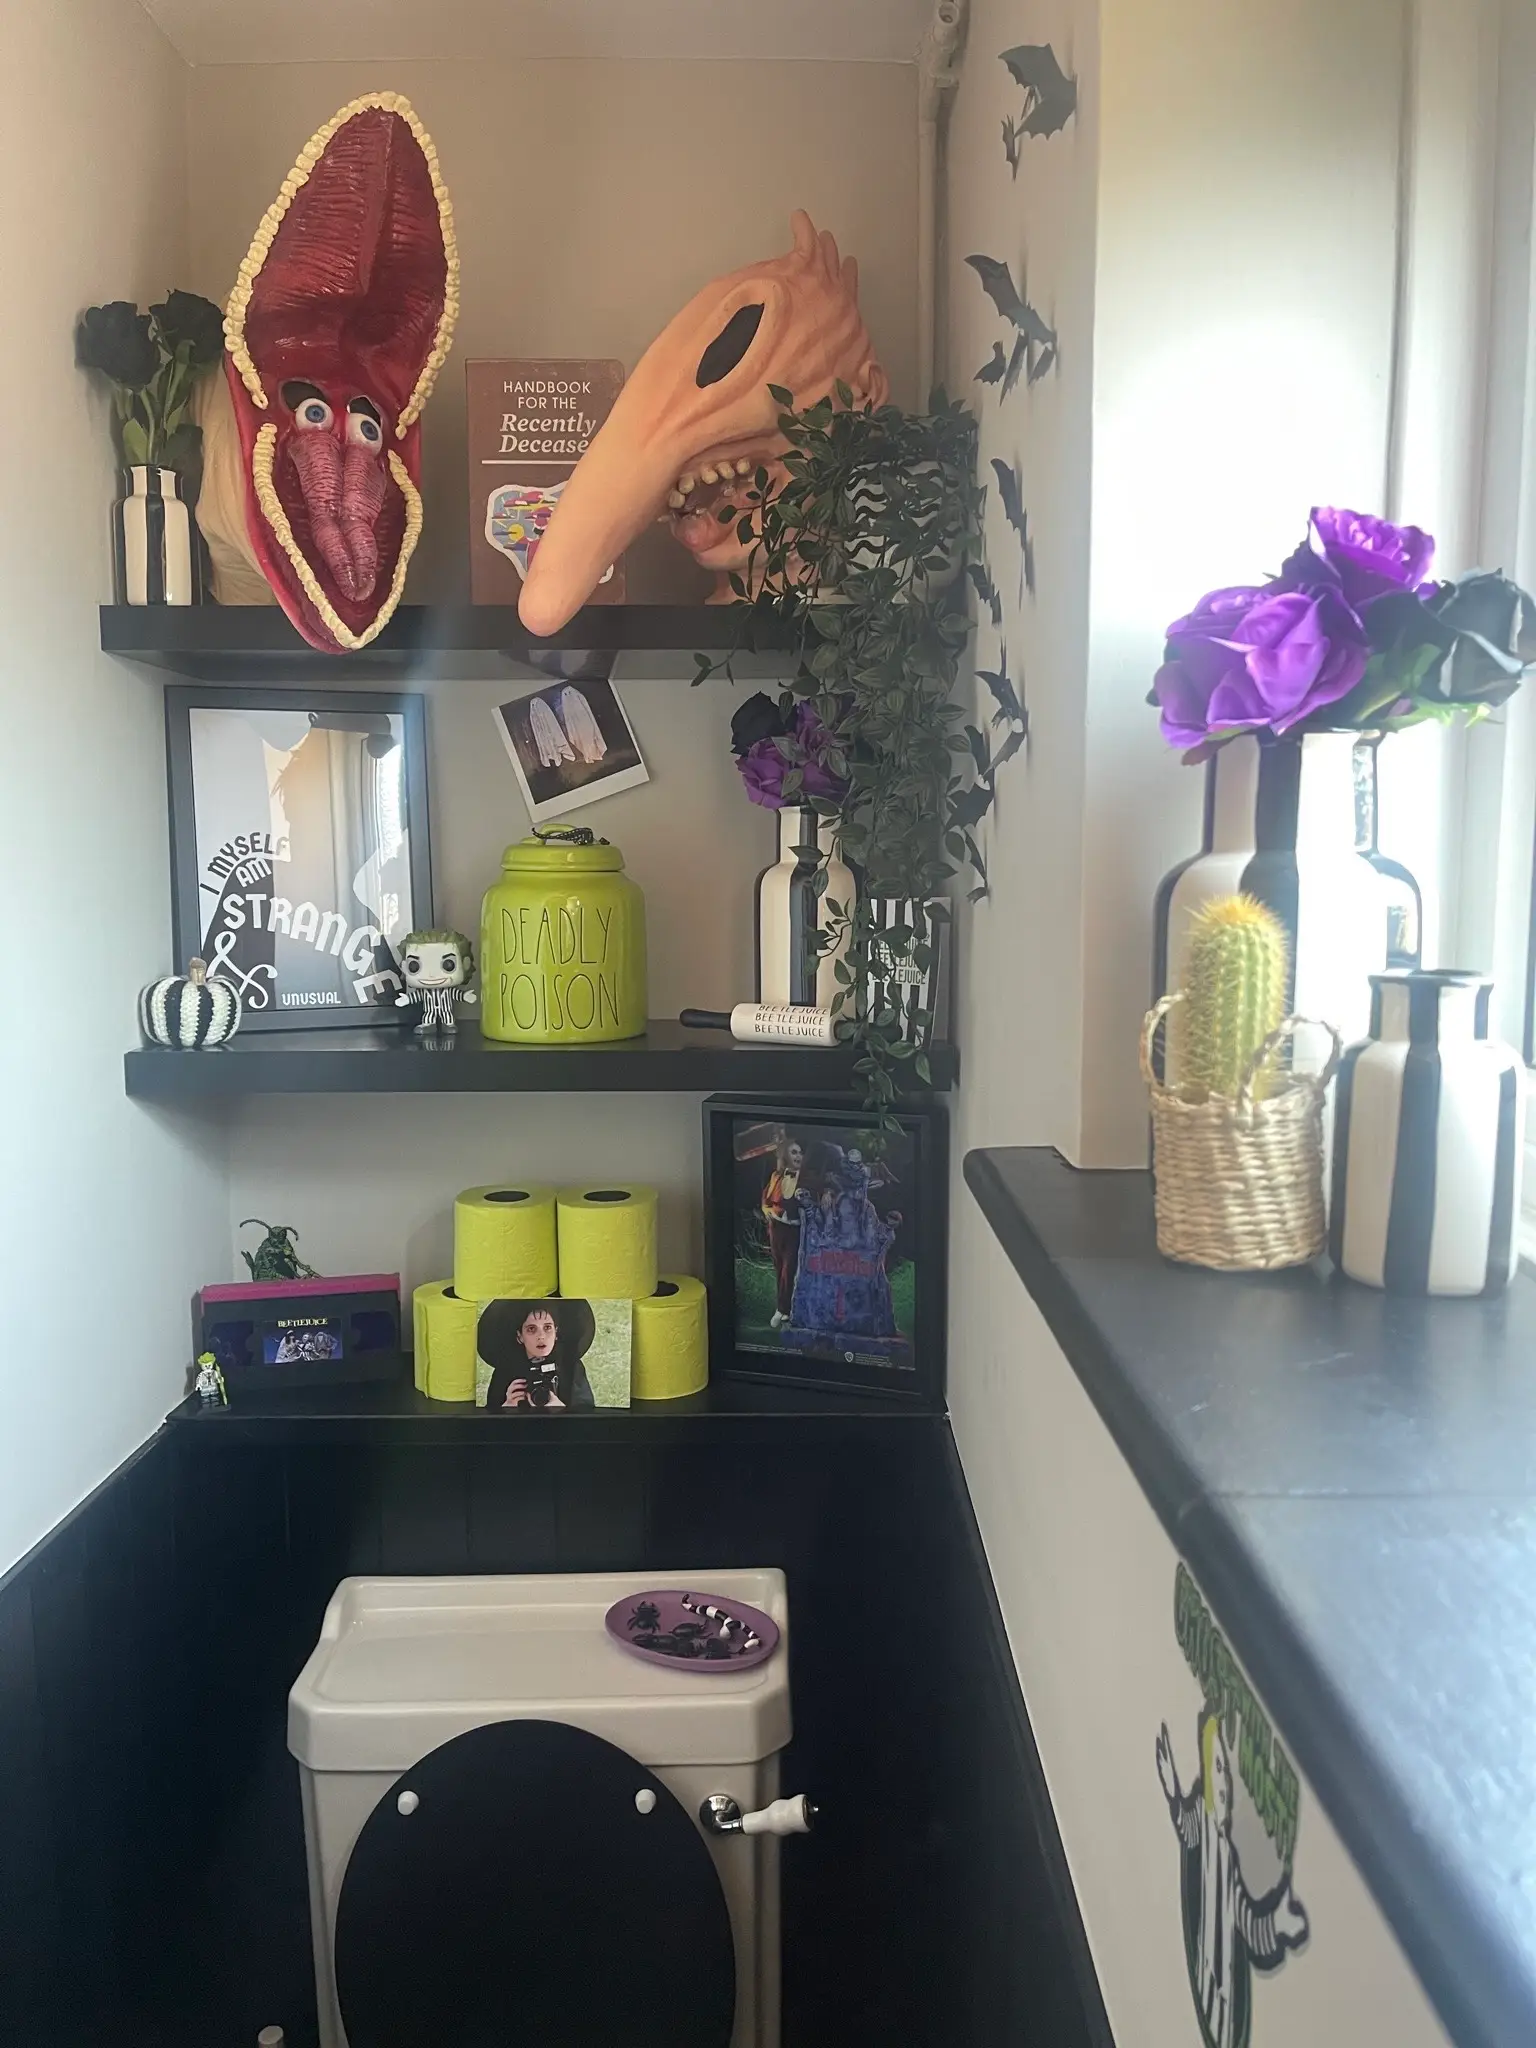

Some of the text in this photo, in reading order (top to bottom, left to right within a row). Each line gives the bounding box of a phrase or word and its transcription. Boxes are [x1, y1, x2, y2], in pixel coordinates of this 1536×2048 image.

[503, 381, 591, 394] HANDBOOK
[518, 397, 577, 409] FOR THE
[500, 412, 596, 437] Recently
[499, 434, 589, 453] Decease
[235, 857, 272, 888] AM
[200, 883, 220, 895] I
[501, 907, 612, 965] DEADLY
[222, 893, 402, 1004] STRANGE
[282, 991, 341, 1006] UNUSUAL
[500, 973, 619, 1030] POISON
[755, 1013, 825, 1026] BEETLEJUICE
[754, 1024, 824, 1038] BEETLEJUICE
[277, 1318, 328, 1328] BEETLEJUICE
